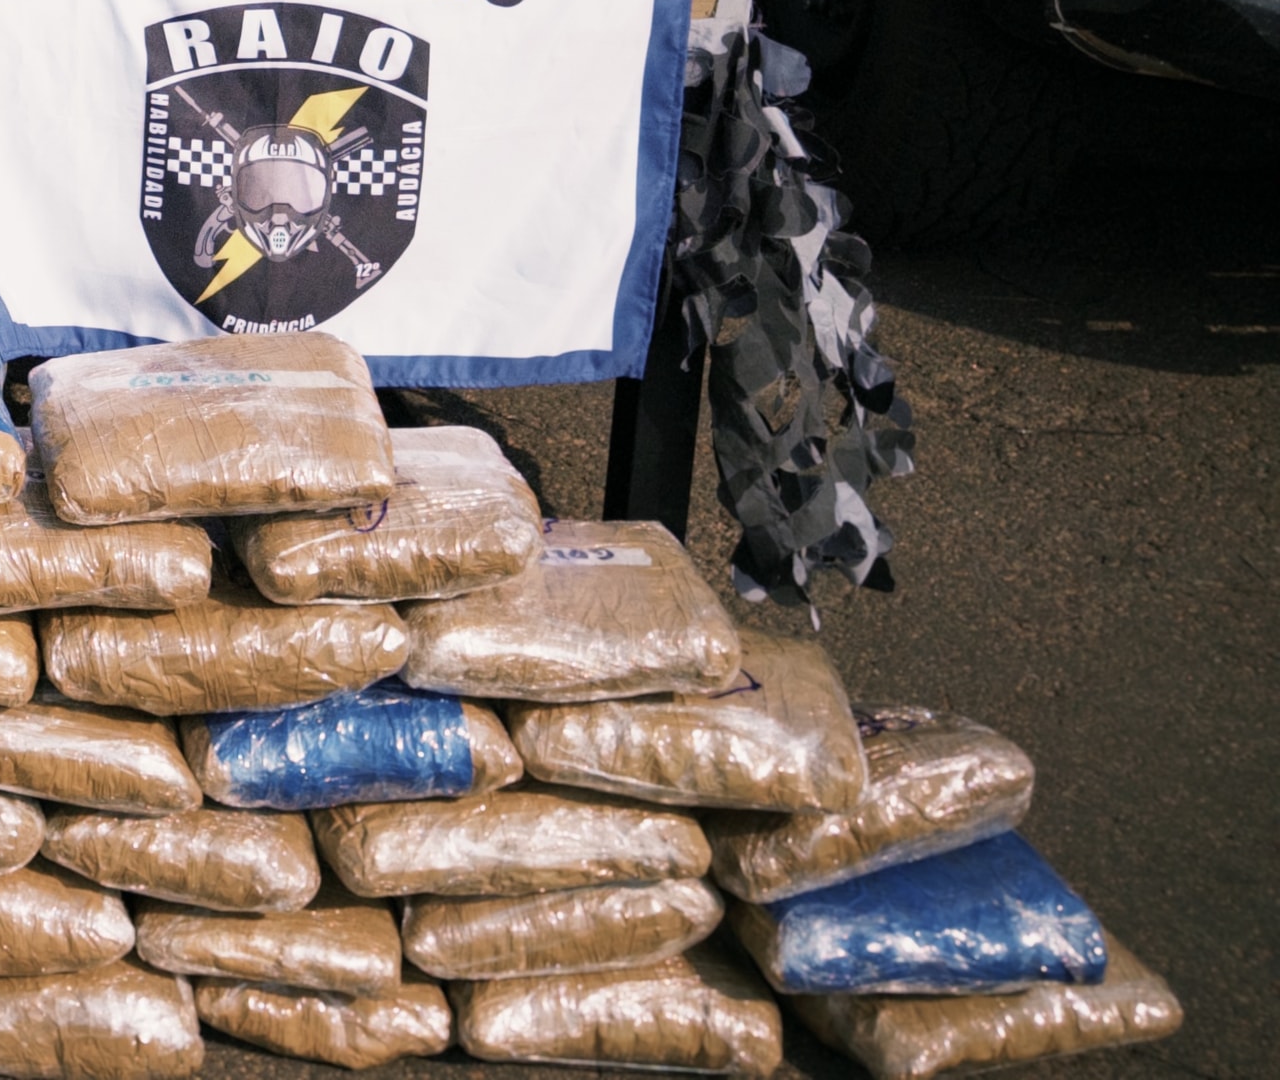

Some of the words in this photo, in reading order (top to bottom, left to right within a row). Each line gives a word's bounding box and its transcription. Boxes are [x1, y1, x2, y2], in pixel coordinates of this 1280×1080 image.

[162, 8, 413, 83] RAIO
[144, 93, 169, 221] HABILIDADE
[269, 143, 296, 157] CAR
[396, 120, 422, 221] AUDÁCIA
